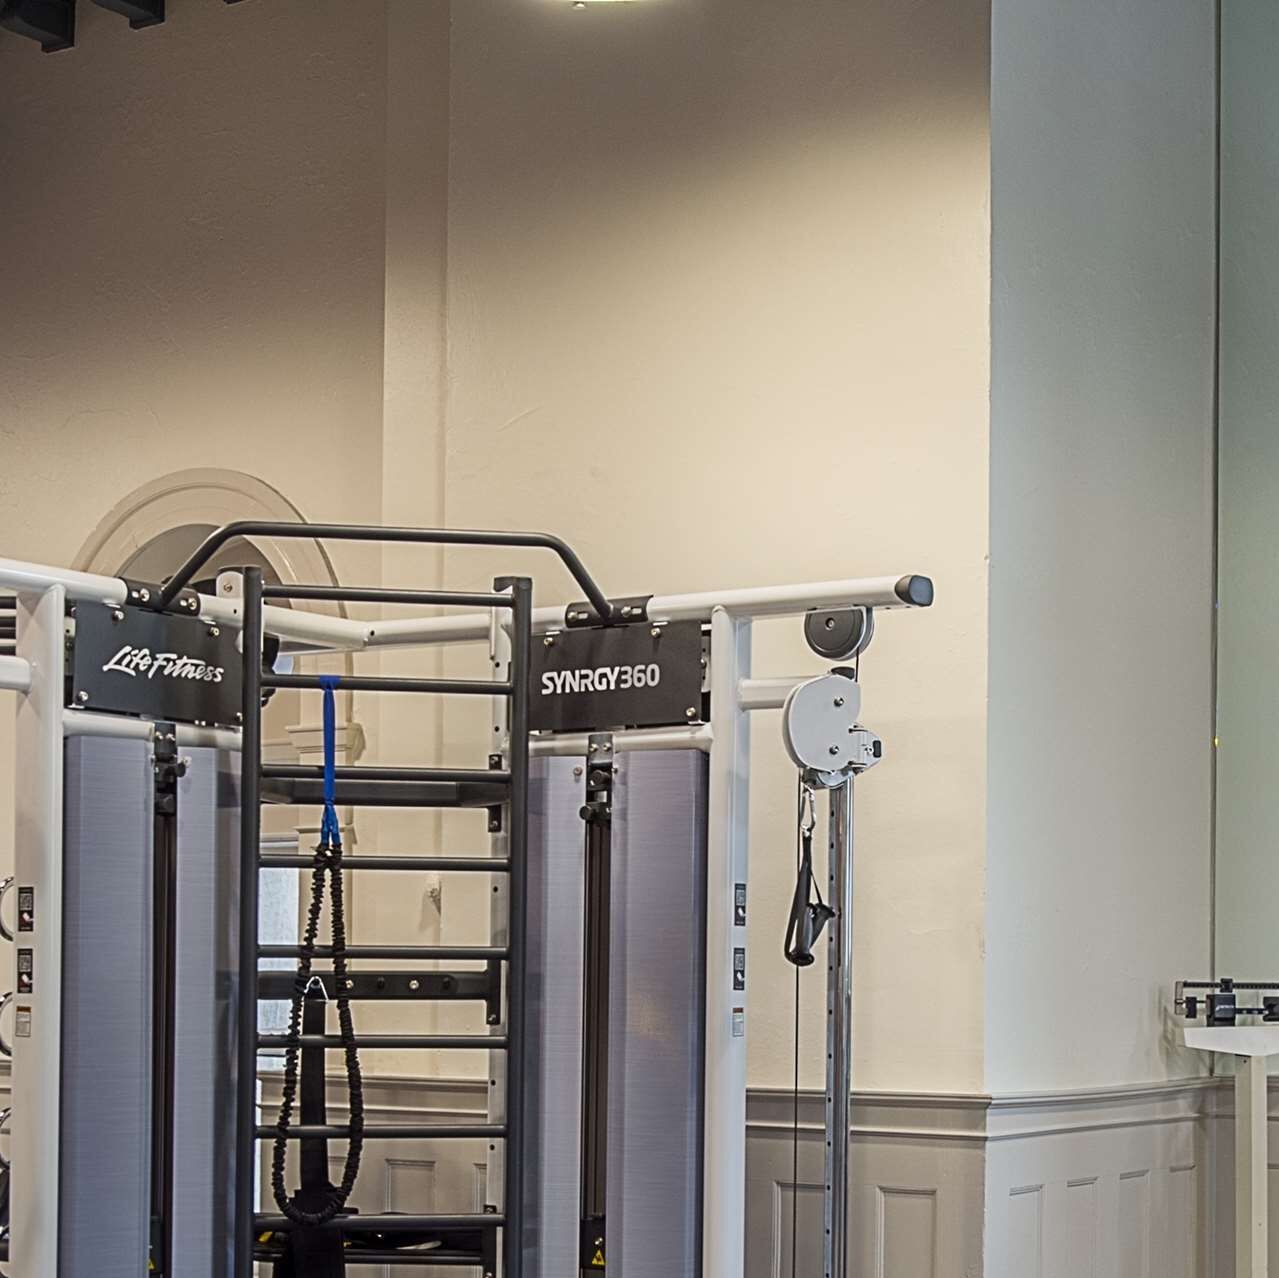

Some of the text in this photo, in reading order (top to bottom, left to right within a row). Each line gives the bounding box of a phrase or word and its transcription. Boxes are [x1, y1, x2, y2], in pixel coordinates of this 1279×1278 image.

[102, 645, 224, 683] Life Fitness
[541, 663, 660, 695] SYNRGY360
